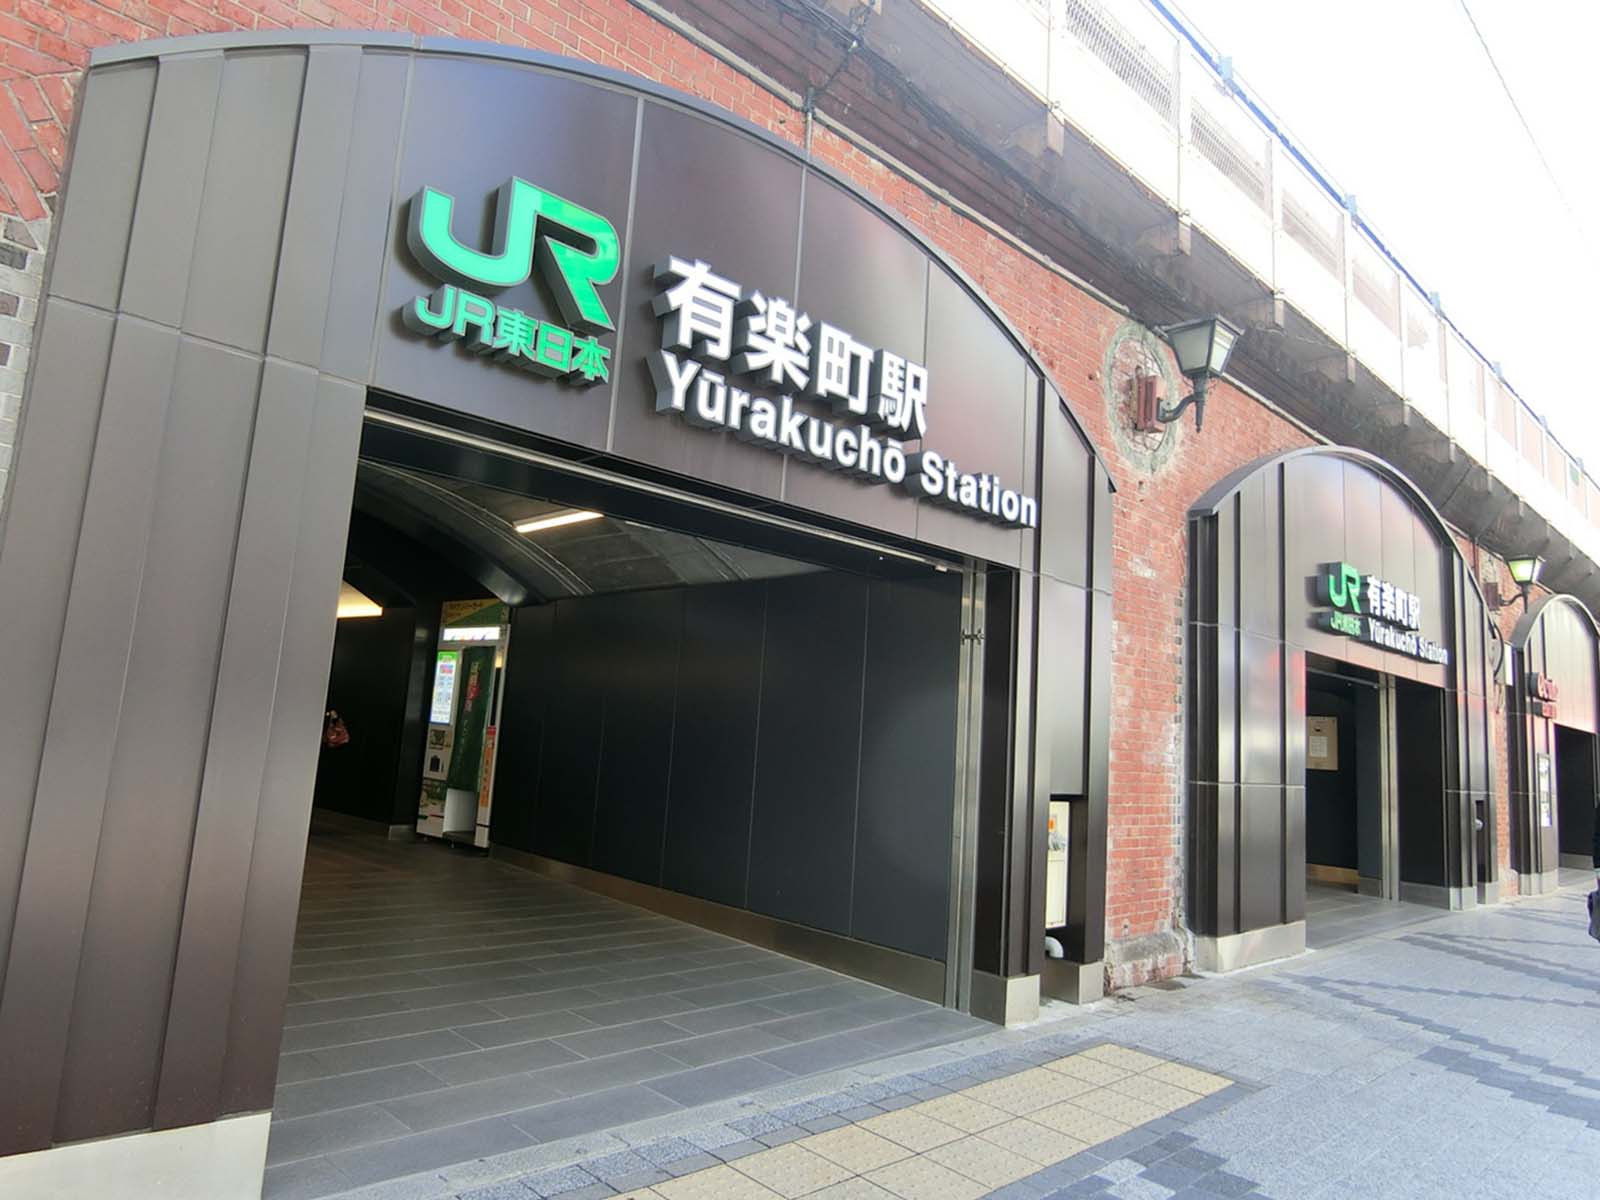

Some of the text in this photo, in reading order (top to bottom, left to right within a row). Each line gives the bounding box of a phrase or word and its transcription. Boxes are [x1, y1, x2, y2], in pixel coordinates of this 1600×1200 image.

[419, 176, 621, 332] JR
[415, 283, 611, 385] JR東日本
[664, 254, 929, 438] 有楽町駅
[660, 349, 1037, 529] Yūrakuchō Station
[1328, 561, 1361, 614] JR
